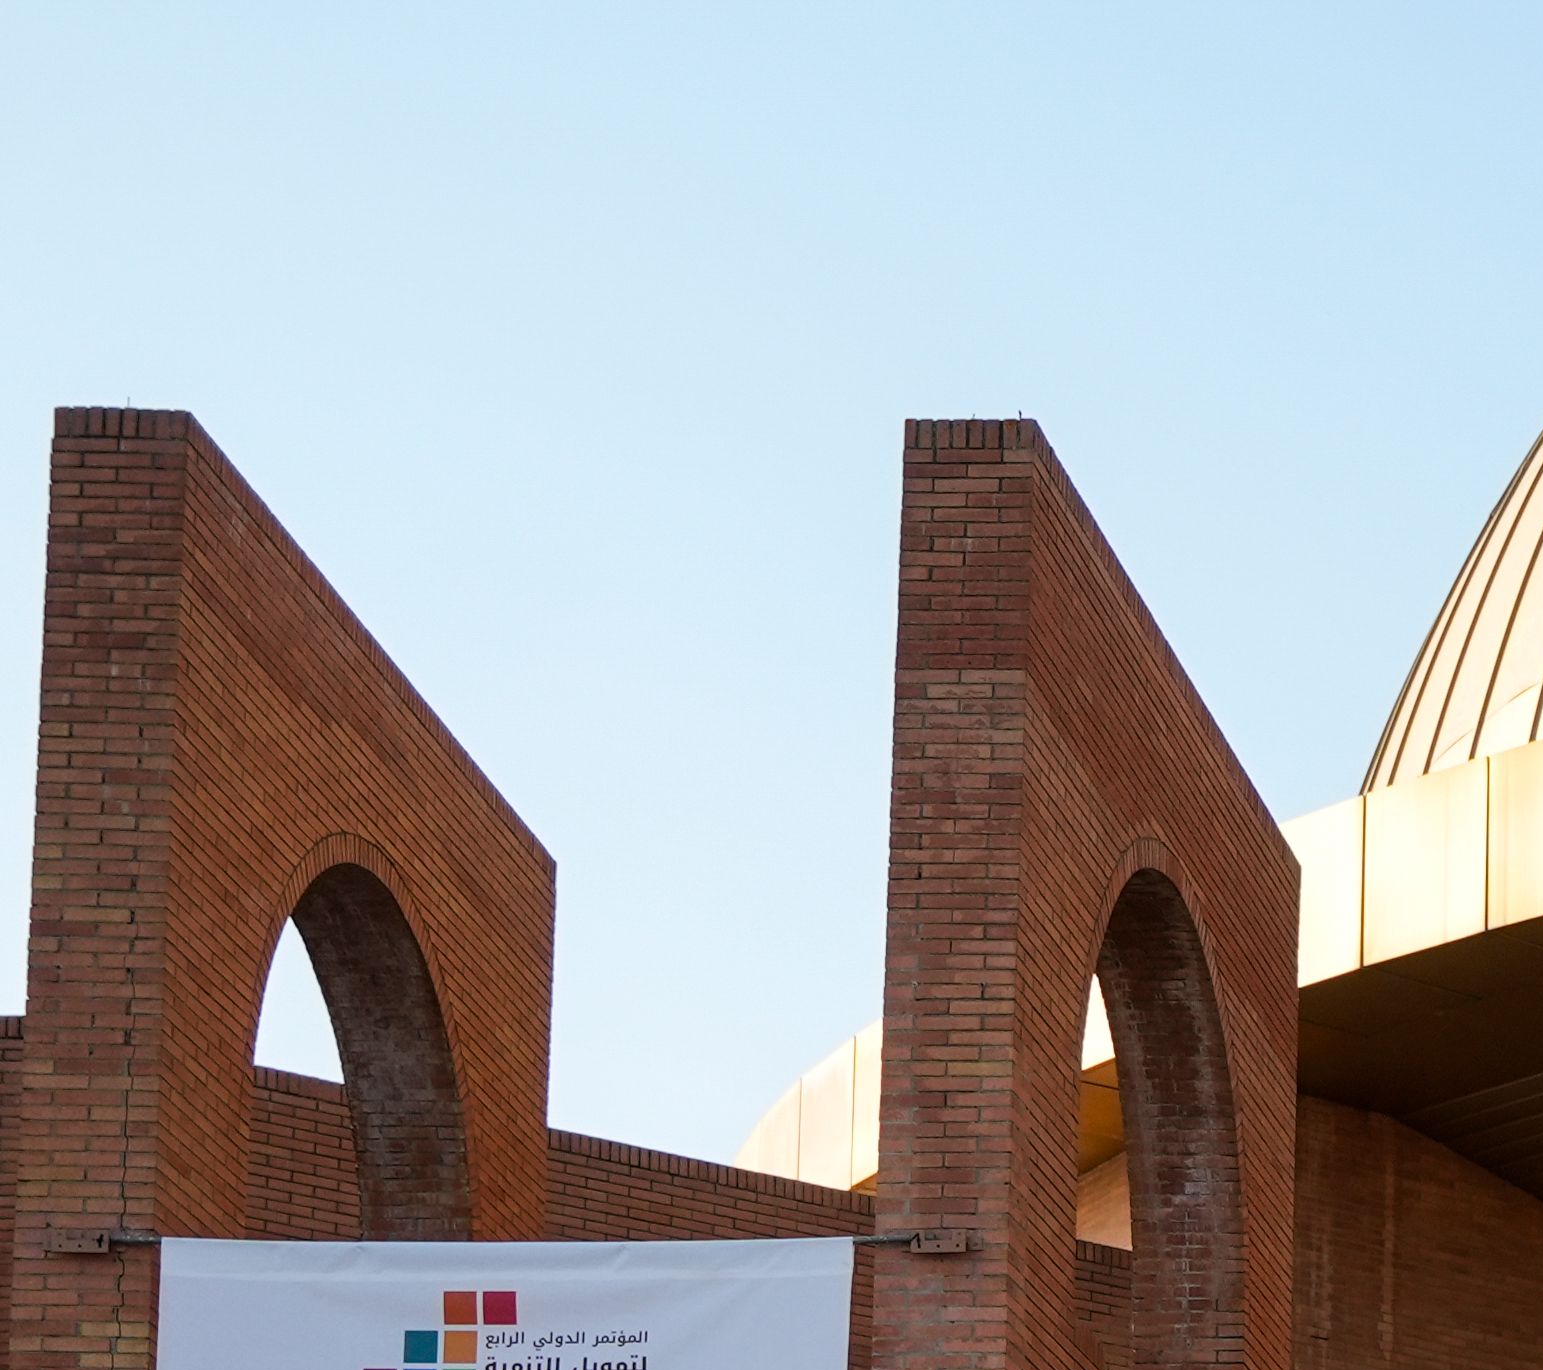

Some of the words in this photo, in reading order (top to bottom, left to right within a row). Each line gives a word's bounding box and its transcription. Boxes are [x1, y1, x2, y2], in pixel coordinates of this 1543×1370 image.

[485, 1331, 525, 1349] الرابع
[532, 1331, 585, 1350] الدولي
[592, 1330, 649, 1347] المؤتمر
